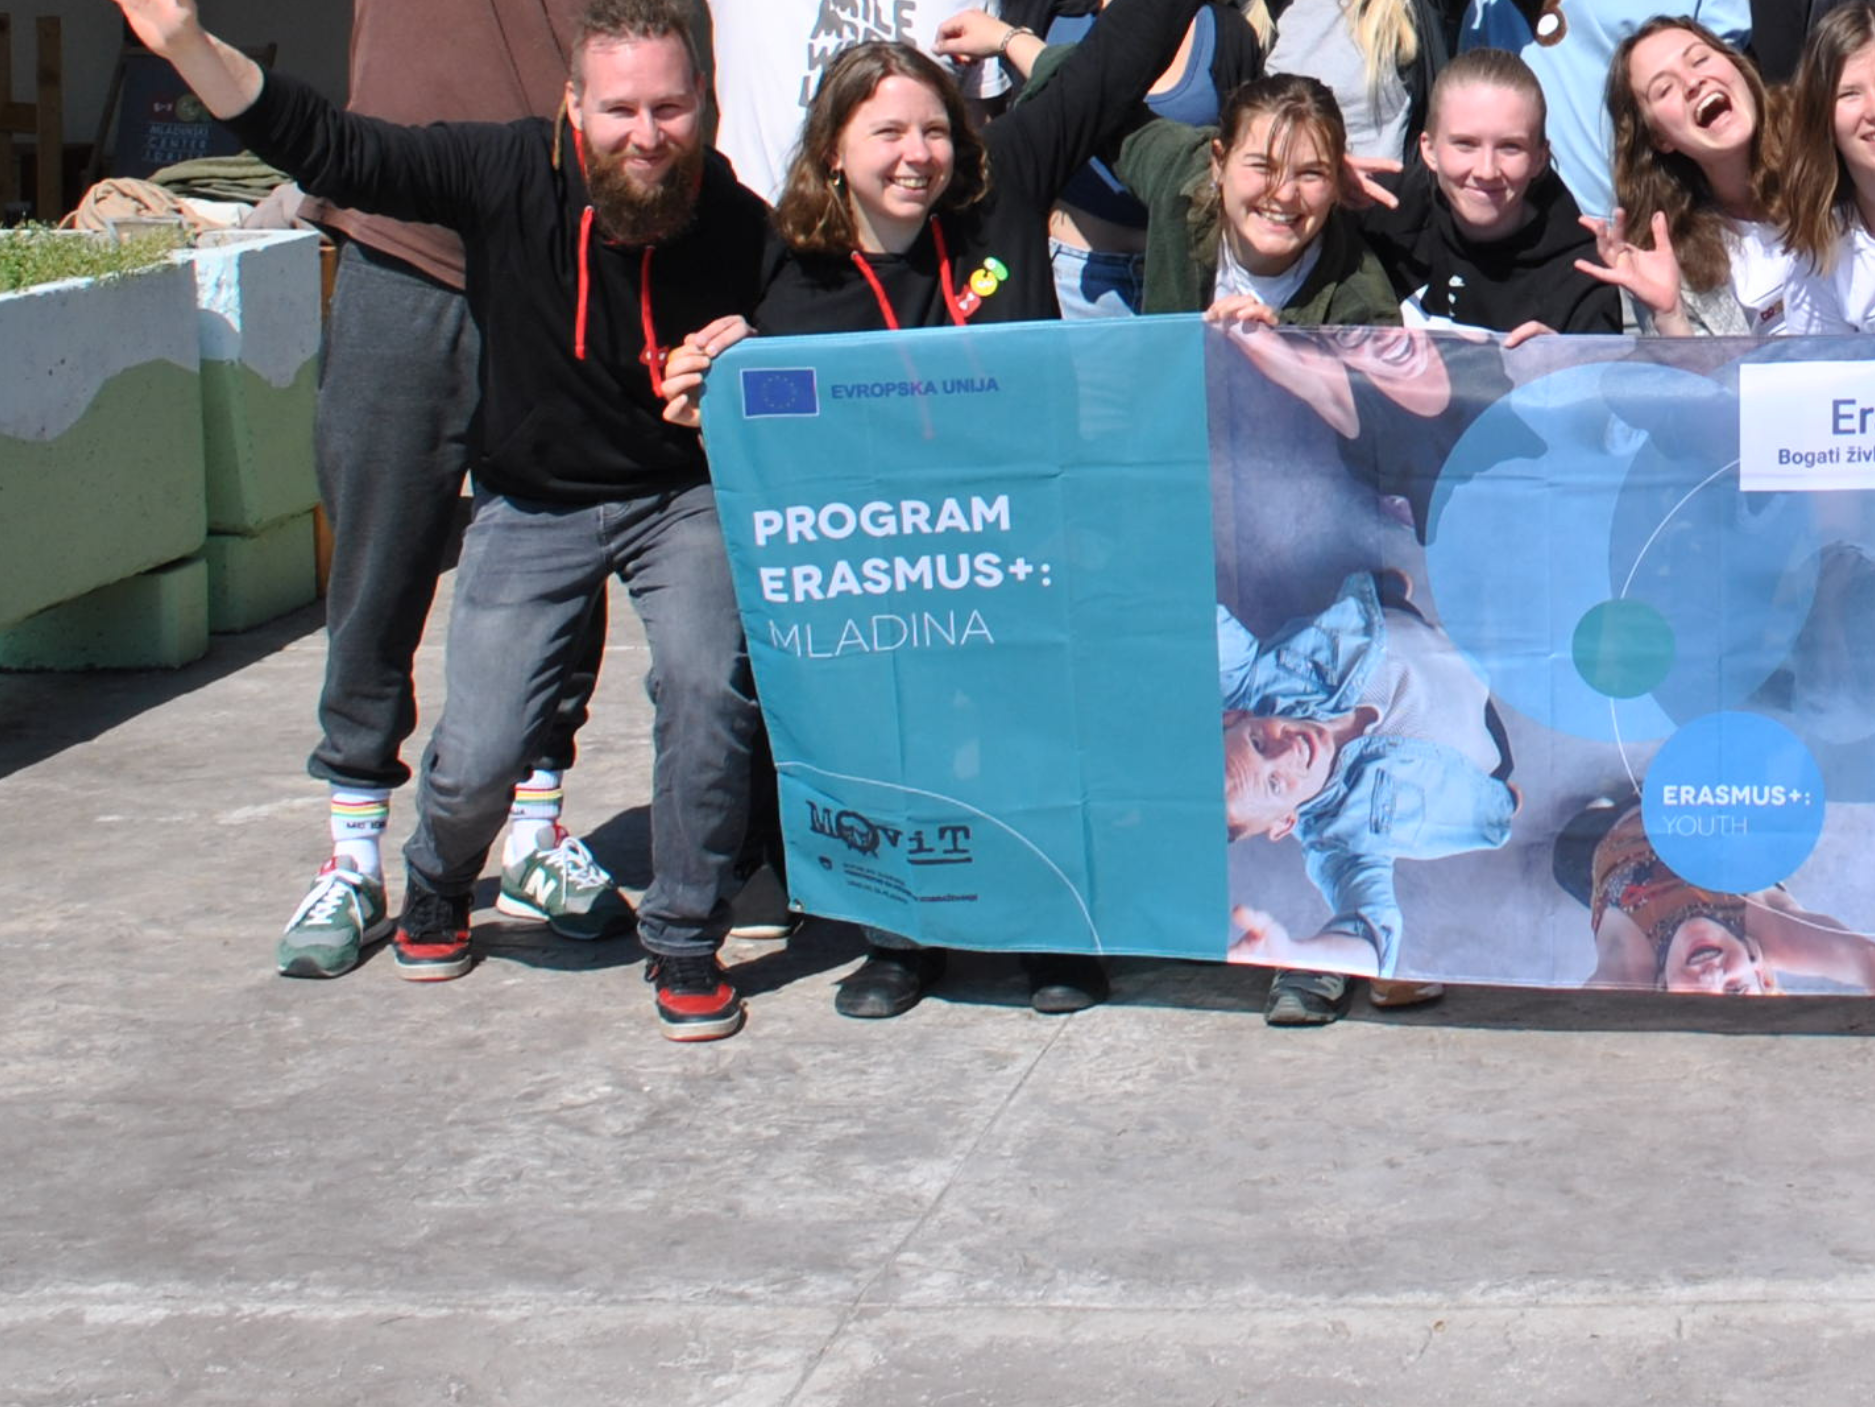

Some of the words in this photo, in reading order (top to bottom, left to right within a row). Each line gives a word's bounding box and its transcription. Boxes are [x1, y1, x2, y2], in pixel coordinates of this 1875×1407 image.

[831, 381, 938, 399] EVROPSKA
[942, 377, 1000, 395] UNIJA
[1778, 447, 1840, 469] Bogati
[753, 495, 1011, 546] PROGRAM
[758, 551, 1052, 603] ERASMUS+:
[768, 609, 995, 658] MLADINA
[1662, 784, 1812, 806] ERASMUS+:
[1662, 814, 1749, 836] YOUTH
